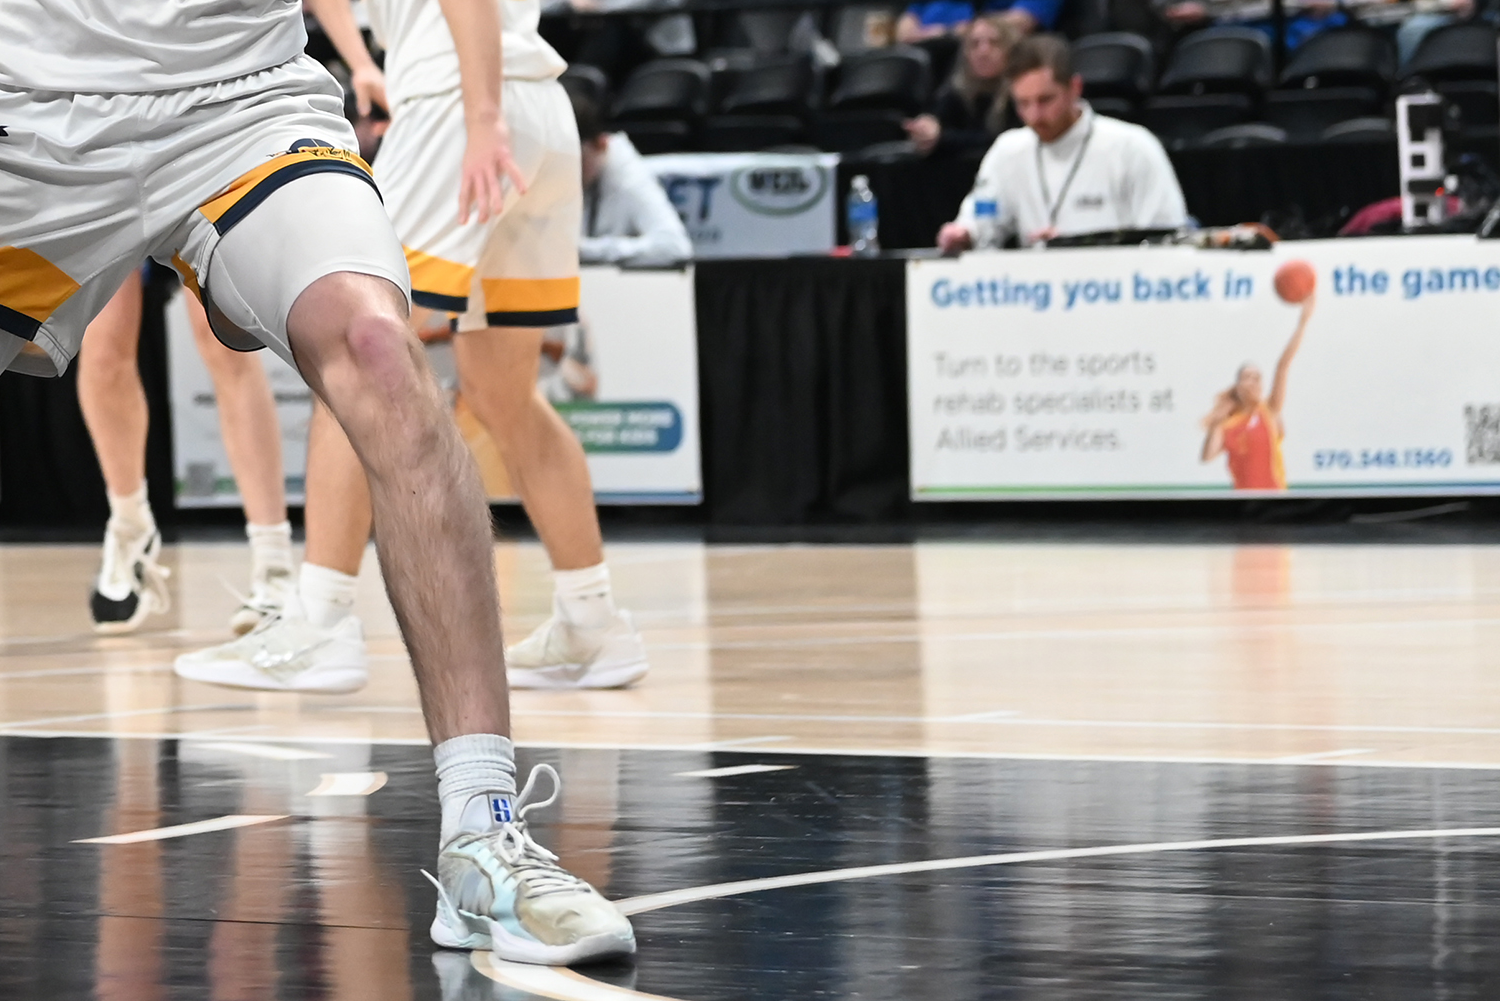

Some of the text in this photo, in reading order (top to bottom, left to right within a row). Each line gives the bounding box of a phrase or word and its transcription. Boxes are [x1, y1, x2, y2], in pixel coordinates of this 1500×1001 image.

[931, 264, 1500, 311] Getting you back in the game
[934, 351, 1157, 381] Turn to the sports
[933, 386, 1174, 418] rehab specialists at
[935, 425, 1007, 452] Allied
